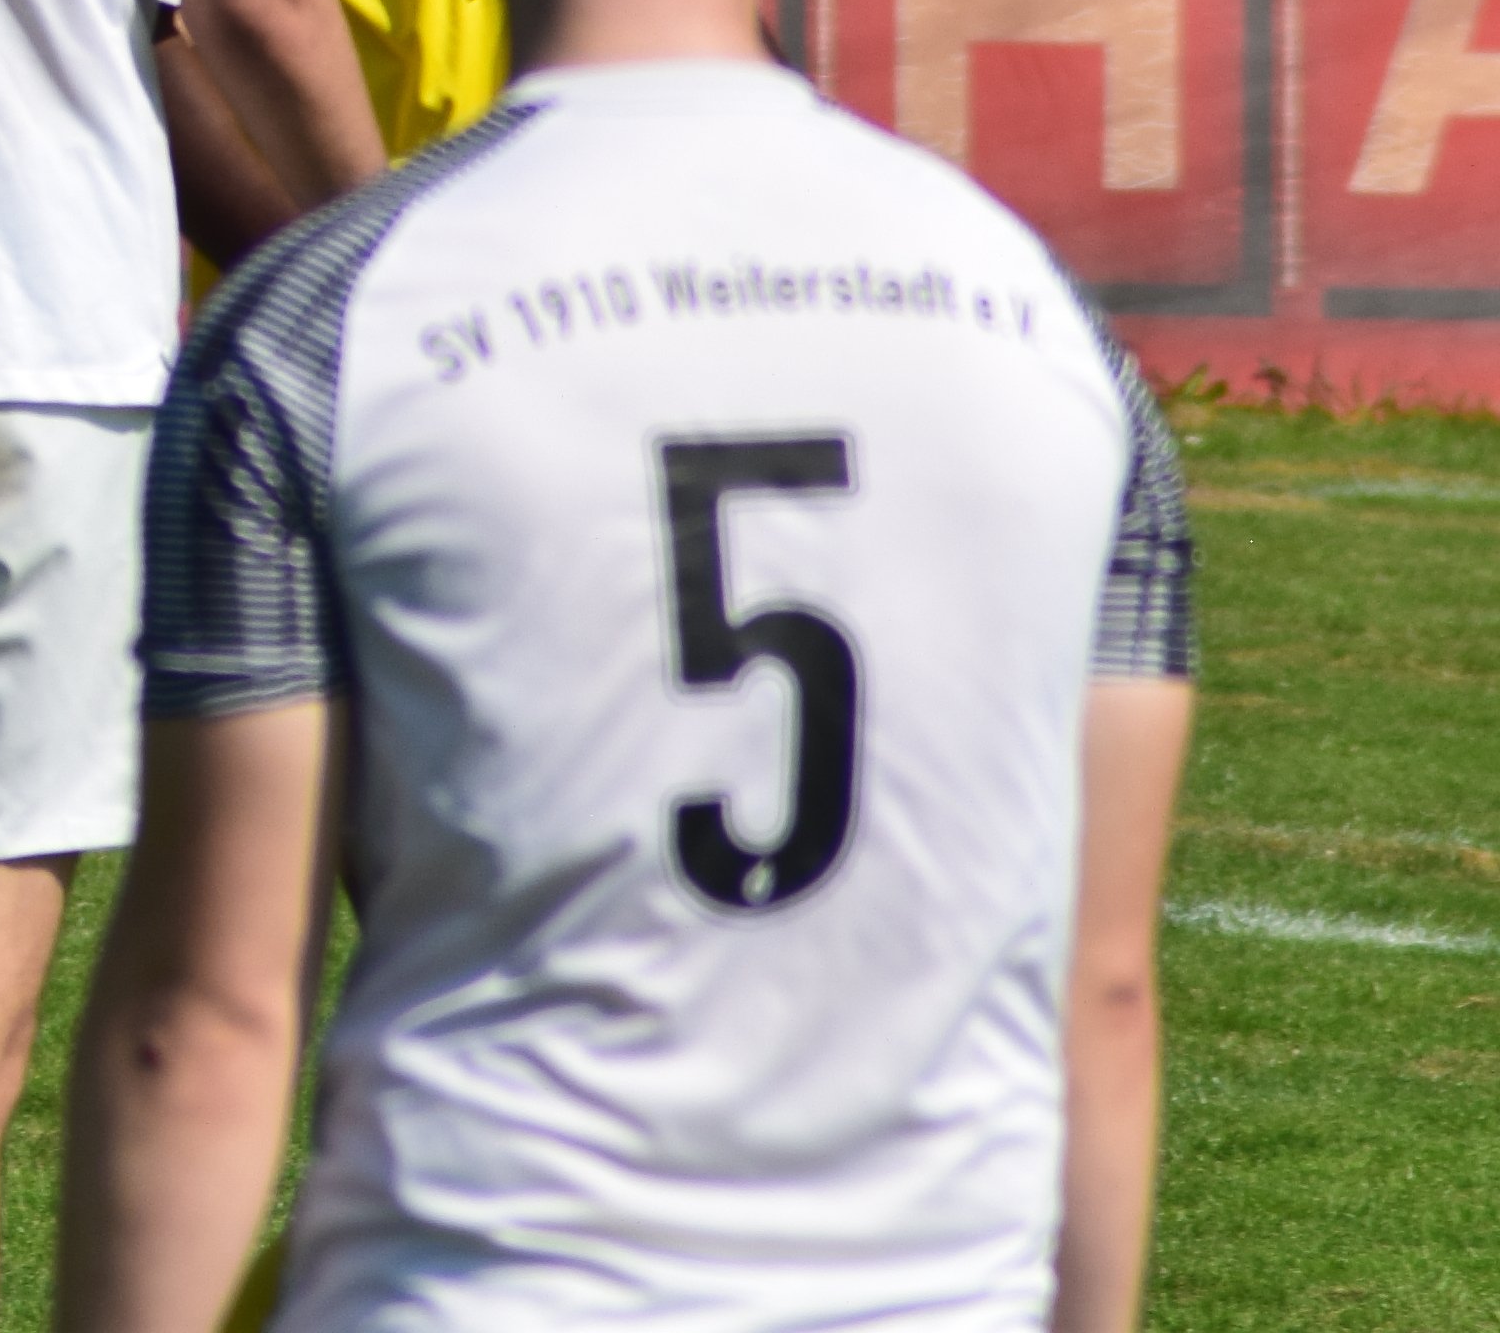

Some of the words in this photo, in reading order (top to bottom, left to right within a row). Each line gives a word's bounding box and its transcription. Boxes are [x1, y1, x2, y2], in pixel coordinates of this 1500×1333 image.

[419, 305, 494, 386] SV
[505, 263, 642, 350] 1910
[648, 252, 959, 321] Weiterstadt
[648, 427, 863, 919] 5
